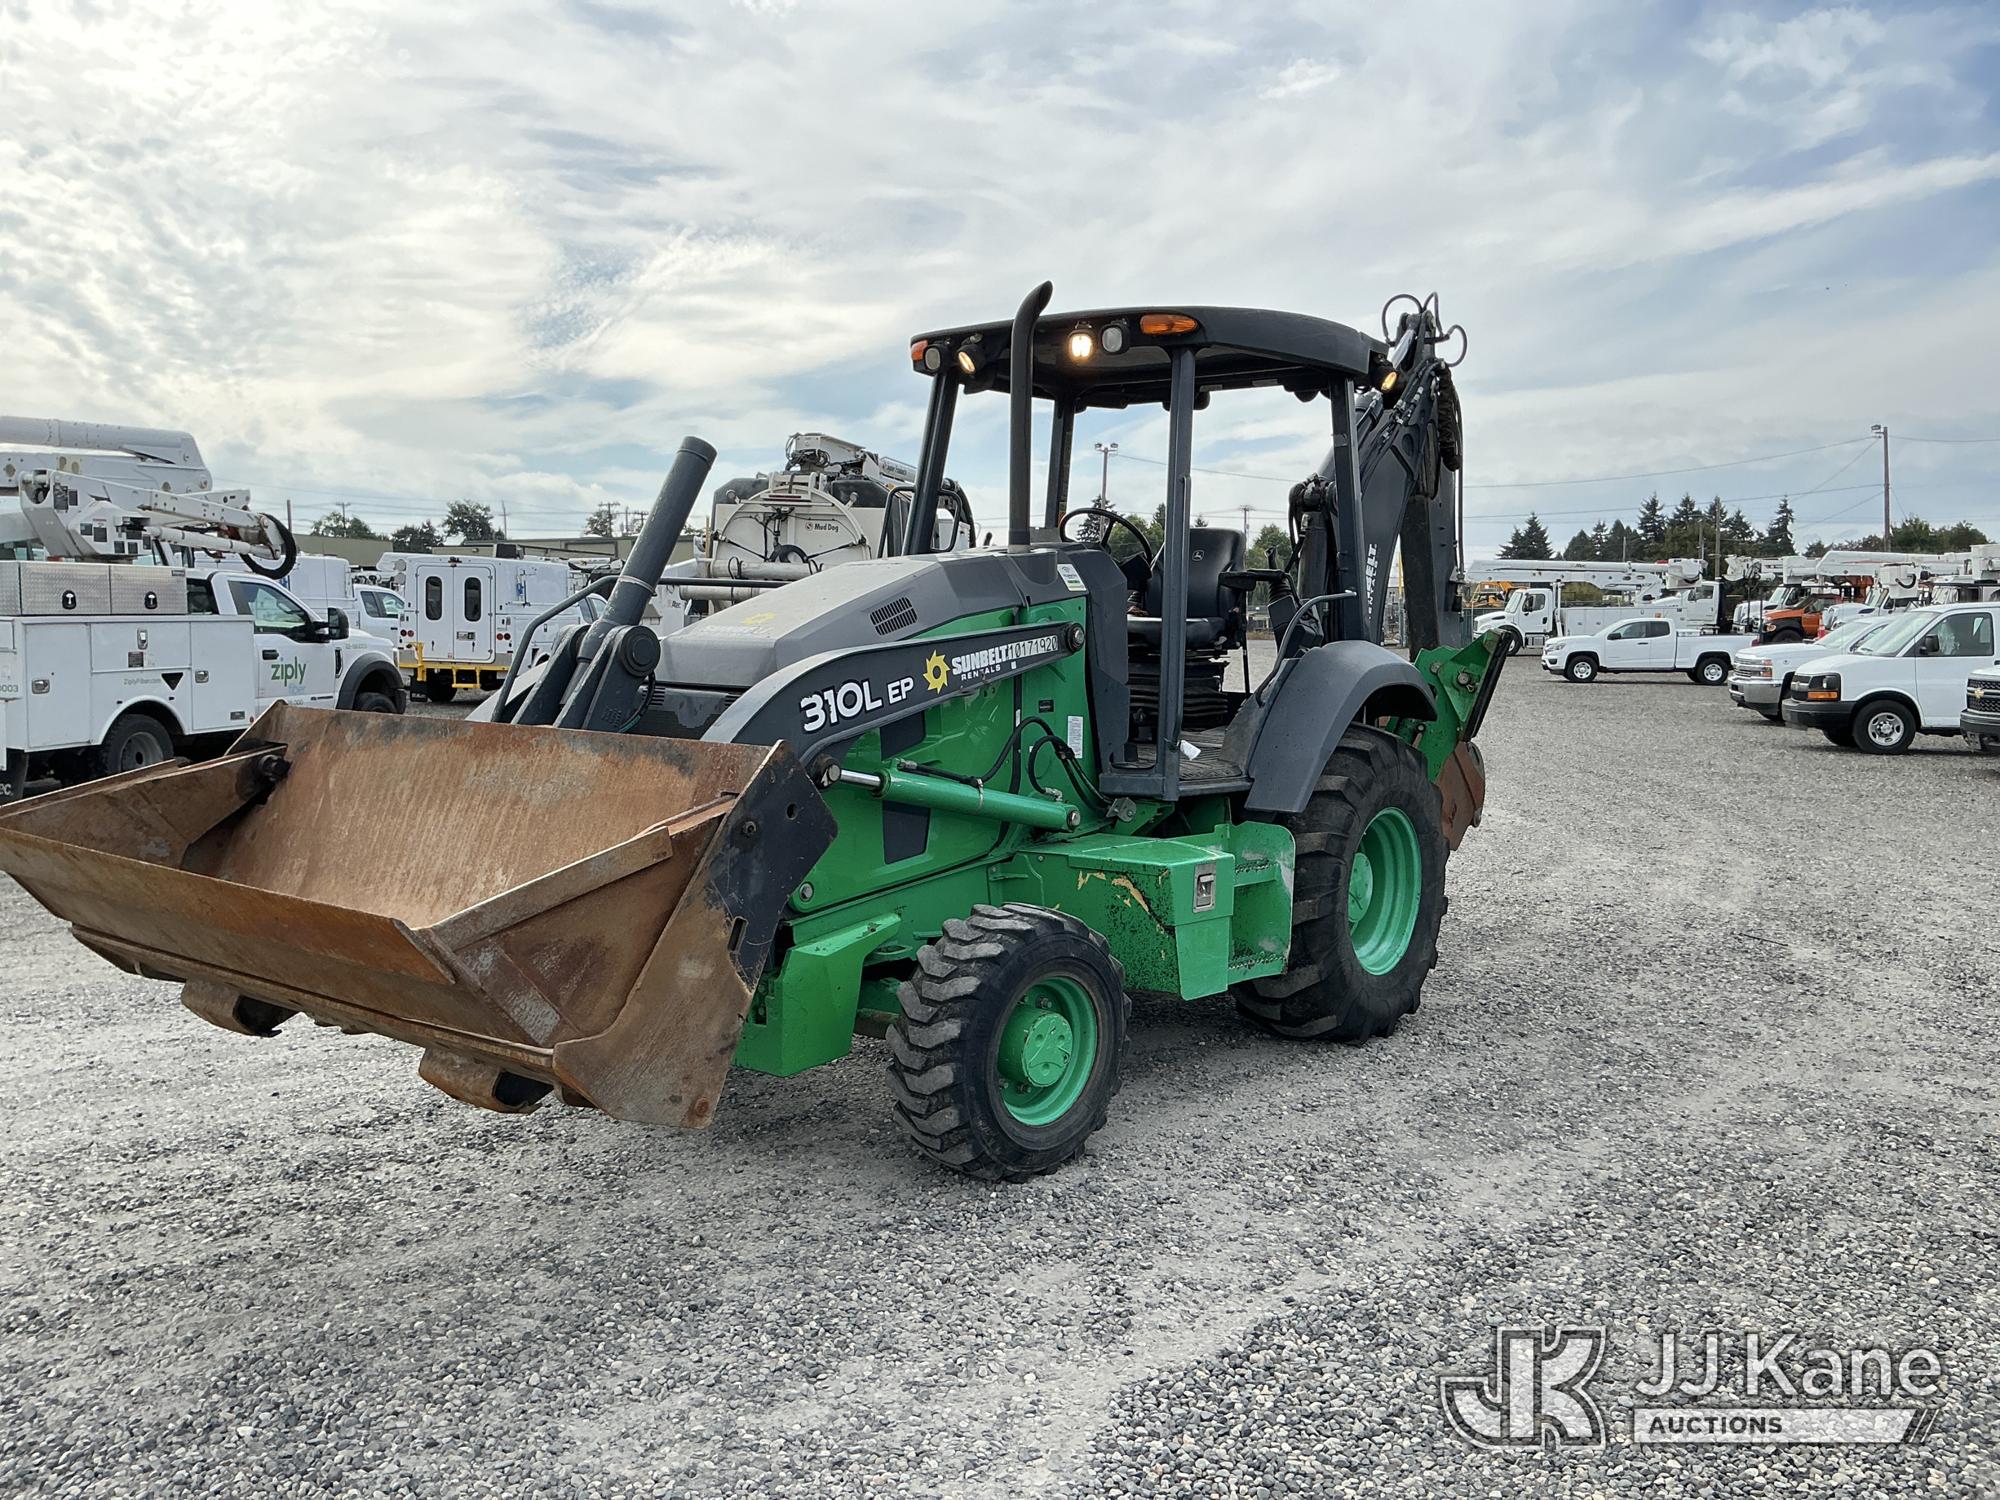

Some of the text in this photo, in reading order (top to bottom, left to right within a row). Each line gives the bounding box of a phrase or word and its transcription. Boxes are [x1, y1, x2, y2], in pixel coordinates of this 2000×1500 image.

[814, 523, 839, 533] Mud Dog
[271, 656, 307, 687] ziply
[951, 635, 1058, 675] SUNBELT 10171920
[800, 677, 914, 732] 310L EP
